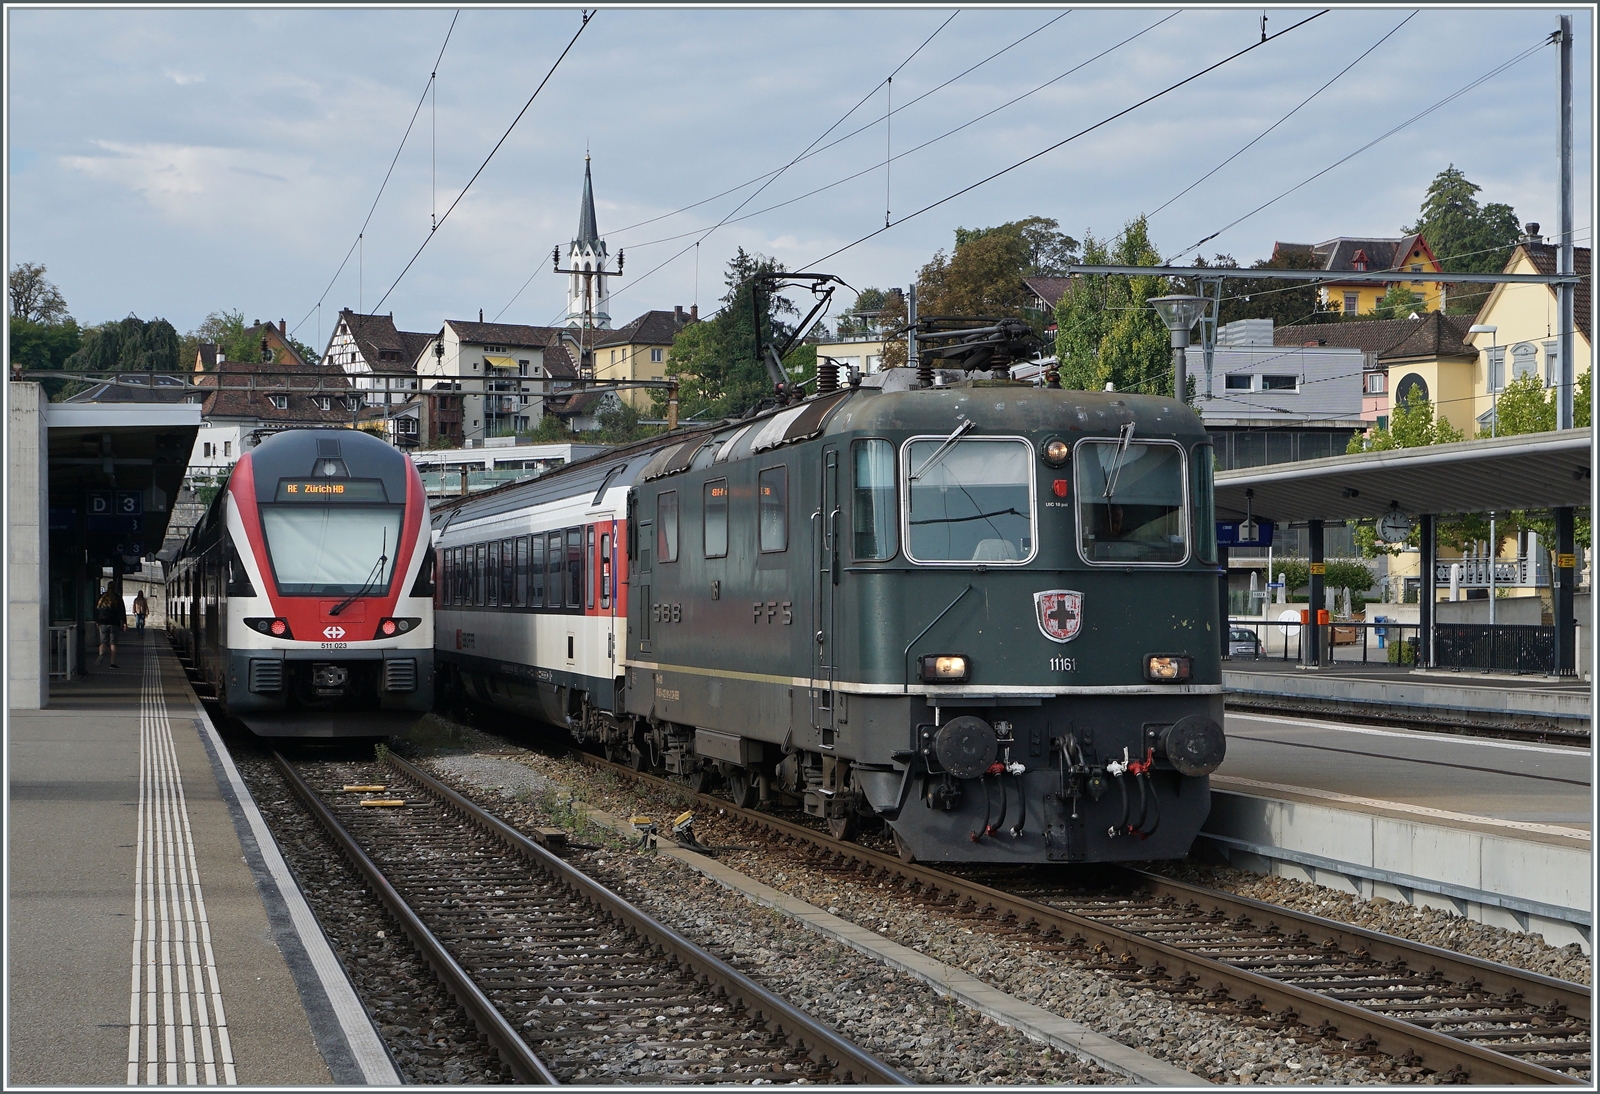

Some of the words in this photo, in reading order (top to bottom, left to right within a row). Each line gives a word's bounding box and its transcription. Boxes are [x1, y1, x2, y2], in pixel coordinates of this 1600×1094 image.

[287, 484, 298, 493] RE
[304, 484, 332, 493] Zürich
[332, 484, 344, 493] HB
[93, 497, 106, 512] D
[123, 497, 135, 512] 3
[613, 524, 618, 548] 2
[116, 543, 124, 552] C
[132, 544, 140, 553] 3
[653, 603, 682, 624] SBB
[753, 601, 793, 625] FFS
[1049, 658, 1076, 671] 11161
